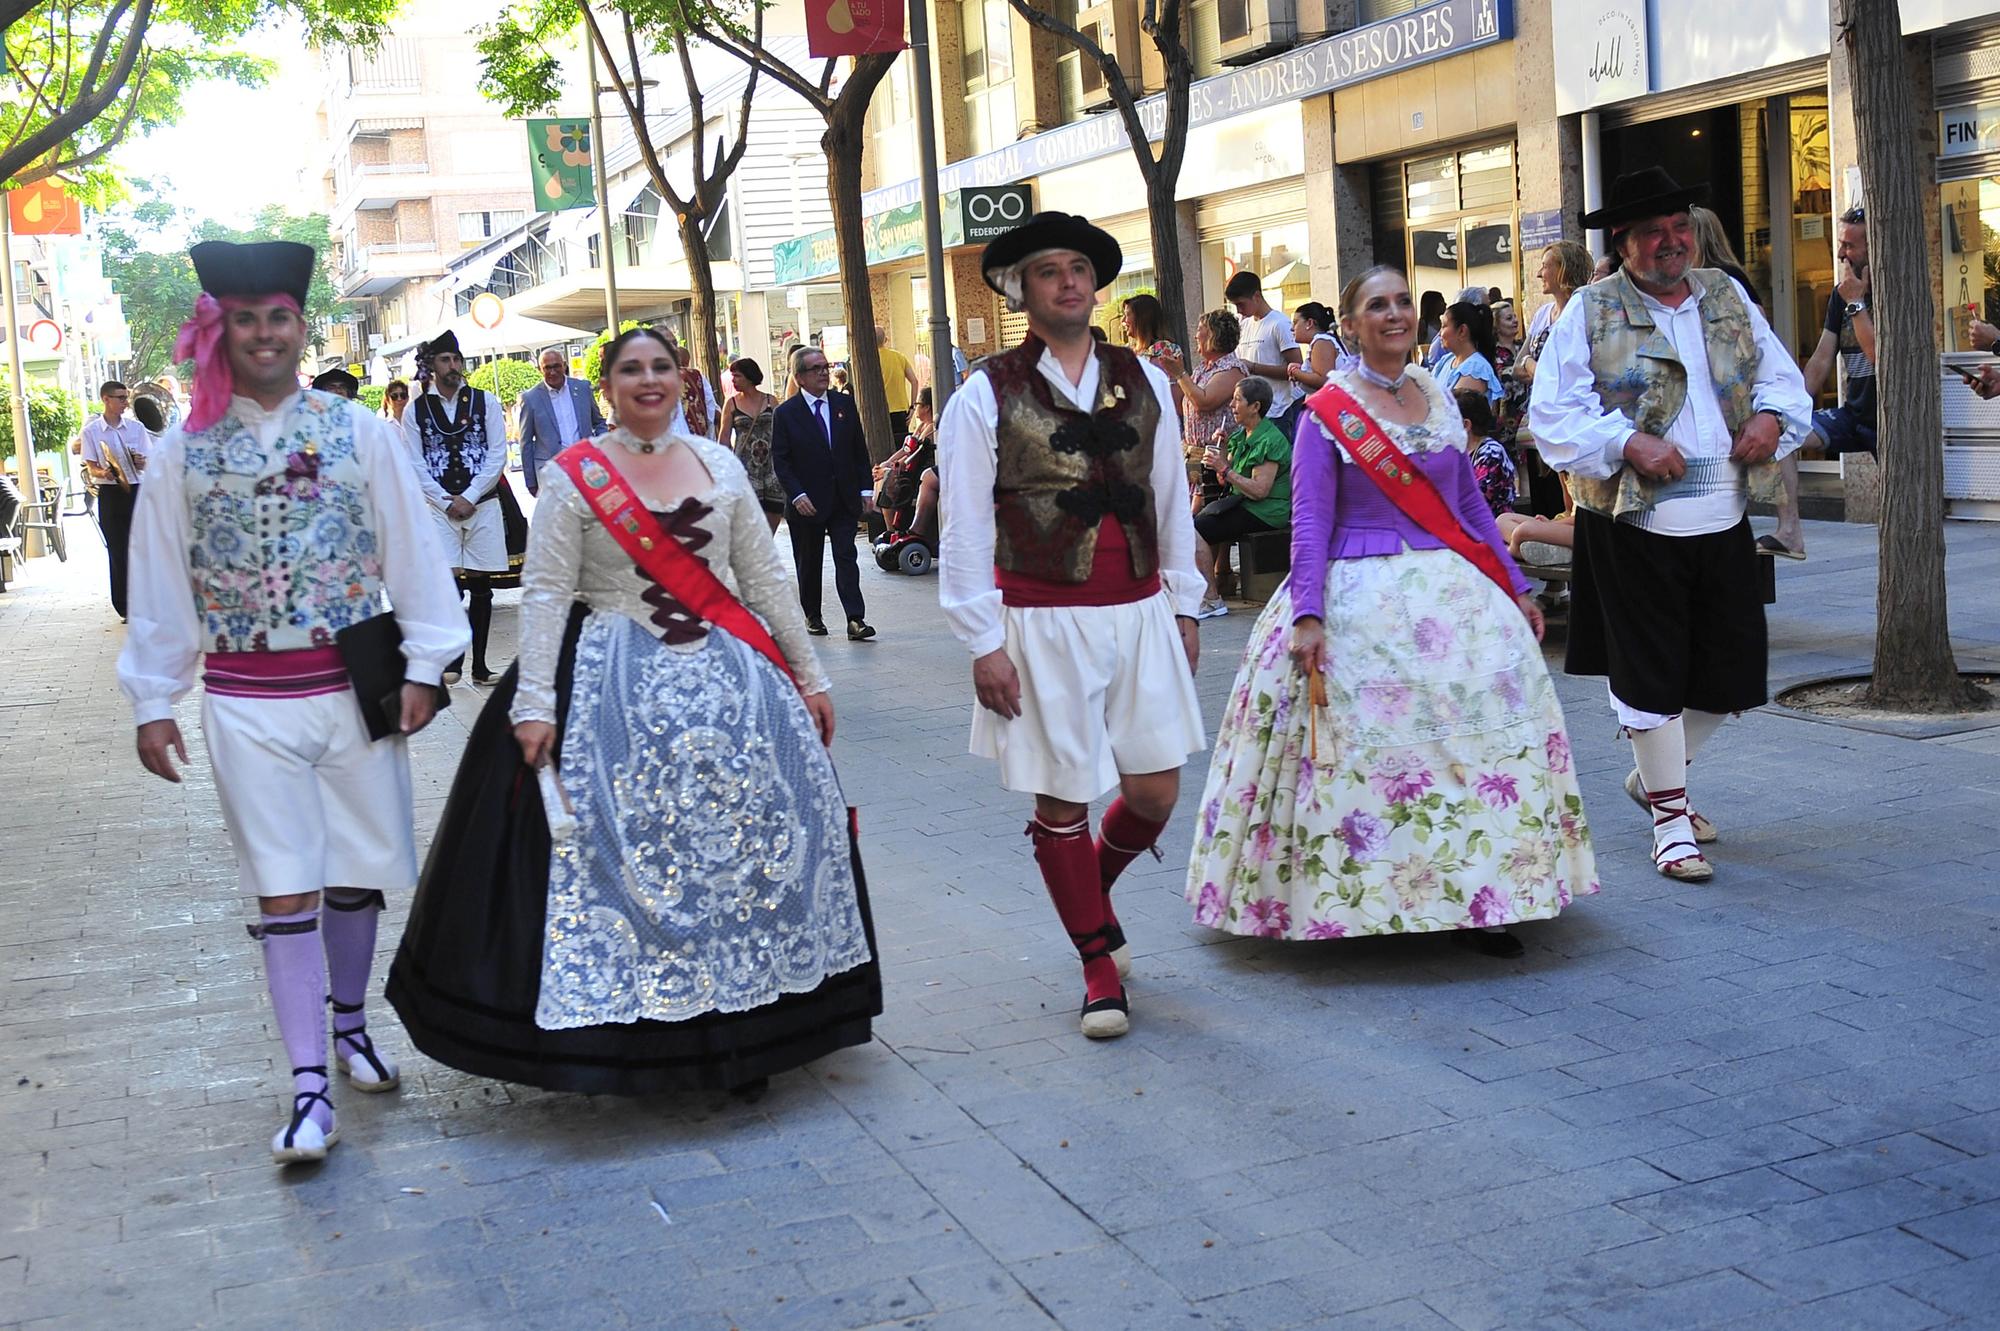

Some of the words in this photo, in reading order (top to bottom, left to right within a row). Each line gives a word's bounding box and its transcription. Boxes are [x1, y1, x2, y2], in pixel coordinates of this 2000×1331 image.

[973, 149, 1023, 185] FISCAL
[1036, 115, 1120, 168] CONTABLE
[1229, 51, 1317, 111] ANDRES
[1323, 6, 1454, 84] ASESORES
[1946, 120, 1977, 144] FIN
